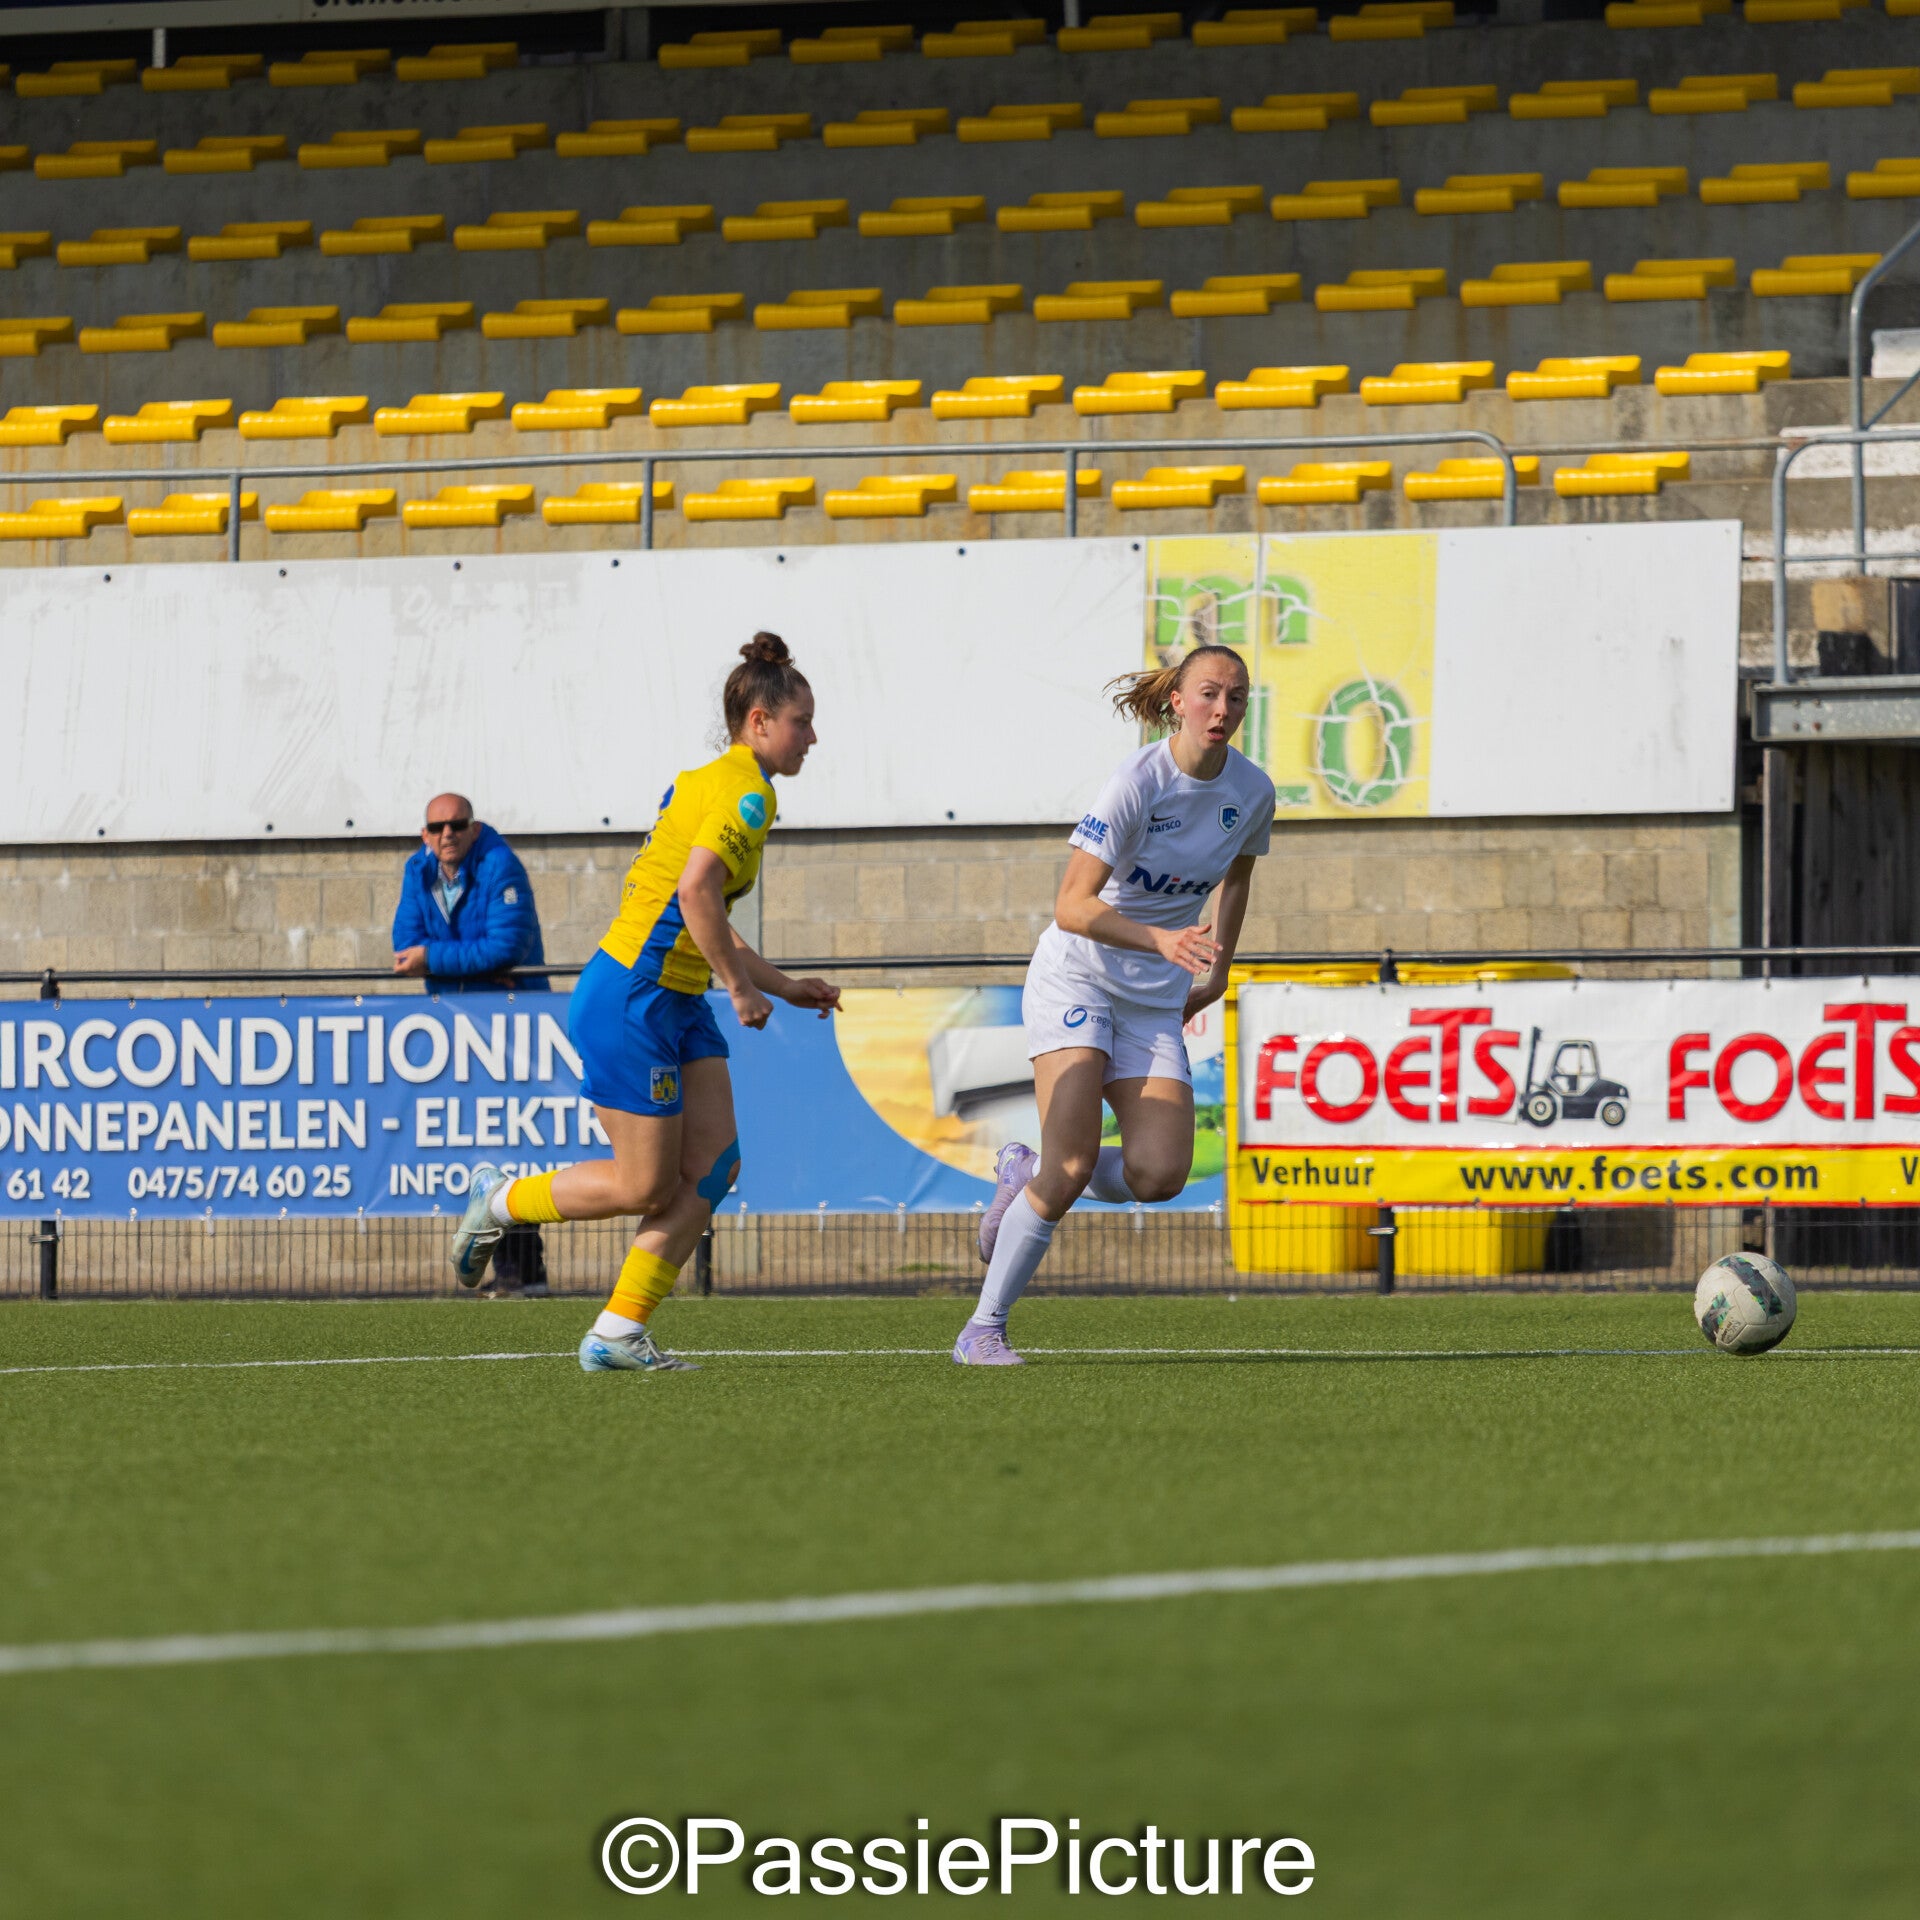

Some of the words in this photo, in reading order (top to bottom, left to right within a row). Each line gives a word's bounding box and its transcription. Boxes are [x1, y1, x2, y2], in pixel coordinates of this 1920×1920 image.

[1080, 813, 1109, 838] AME
[0, 1013, 584, 1089] IRCONDITIONIN
[1255, 1007, 1521, 1124] FOETS
[0, 1099, 366, 1152] NNEPANELEN
[415, 1096, 612, 1147] ELEKTR
[6, 1167, 45, 1200] 61
[51, 1167, 91, 1199] 42
[127, 1165, 260, 1199] 0475/74
[266, 1165, 306, 1198] 60
[312, 1164, 351, 1197] 25
[1250, 1156, 1375, 1186] Verhuur
[1460, 1155, 1819, 1191] www.foets.com
